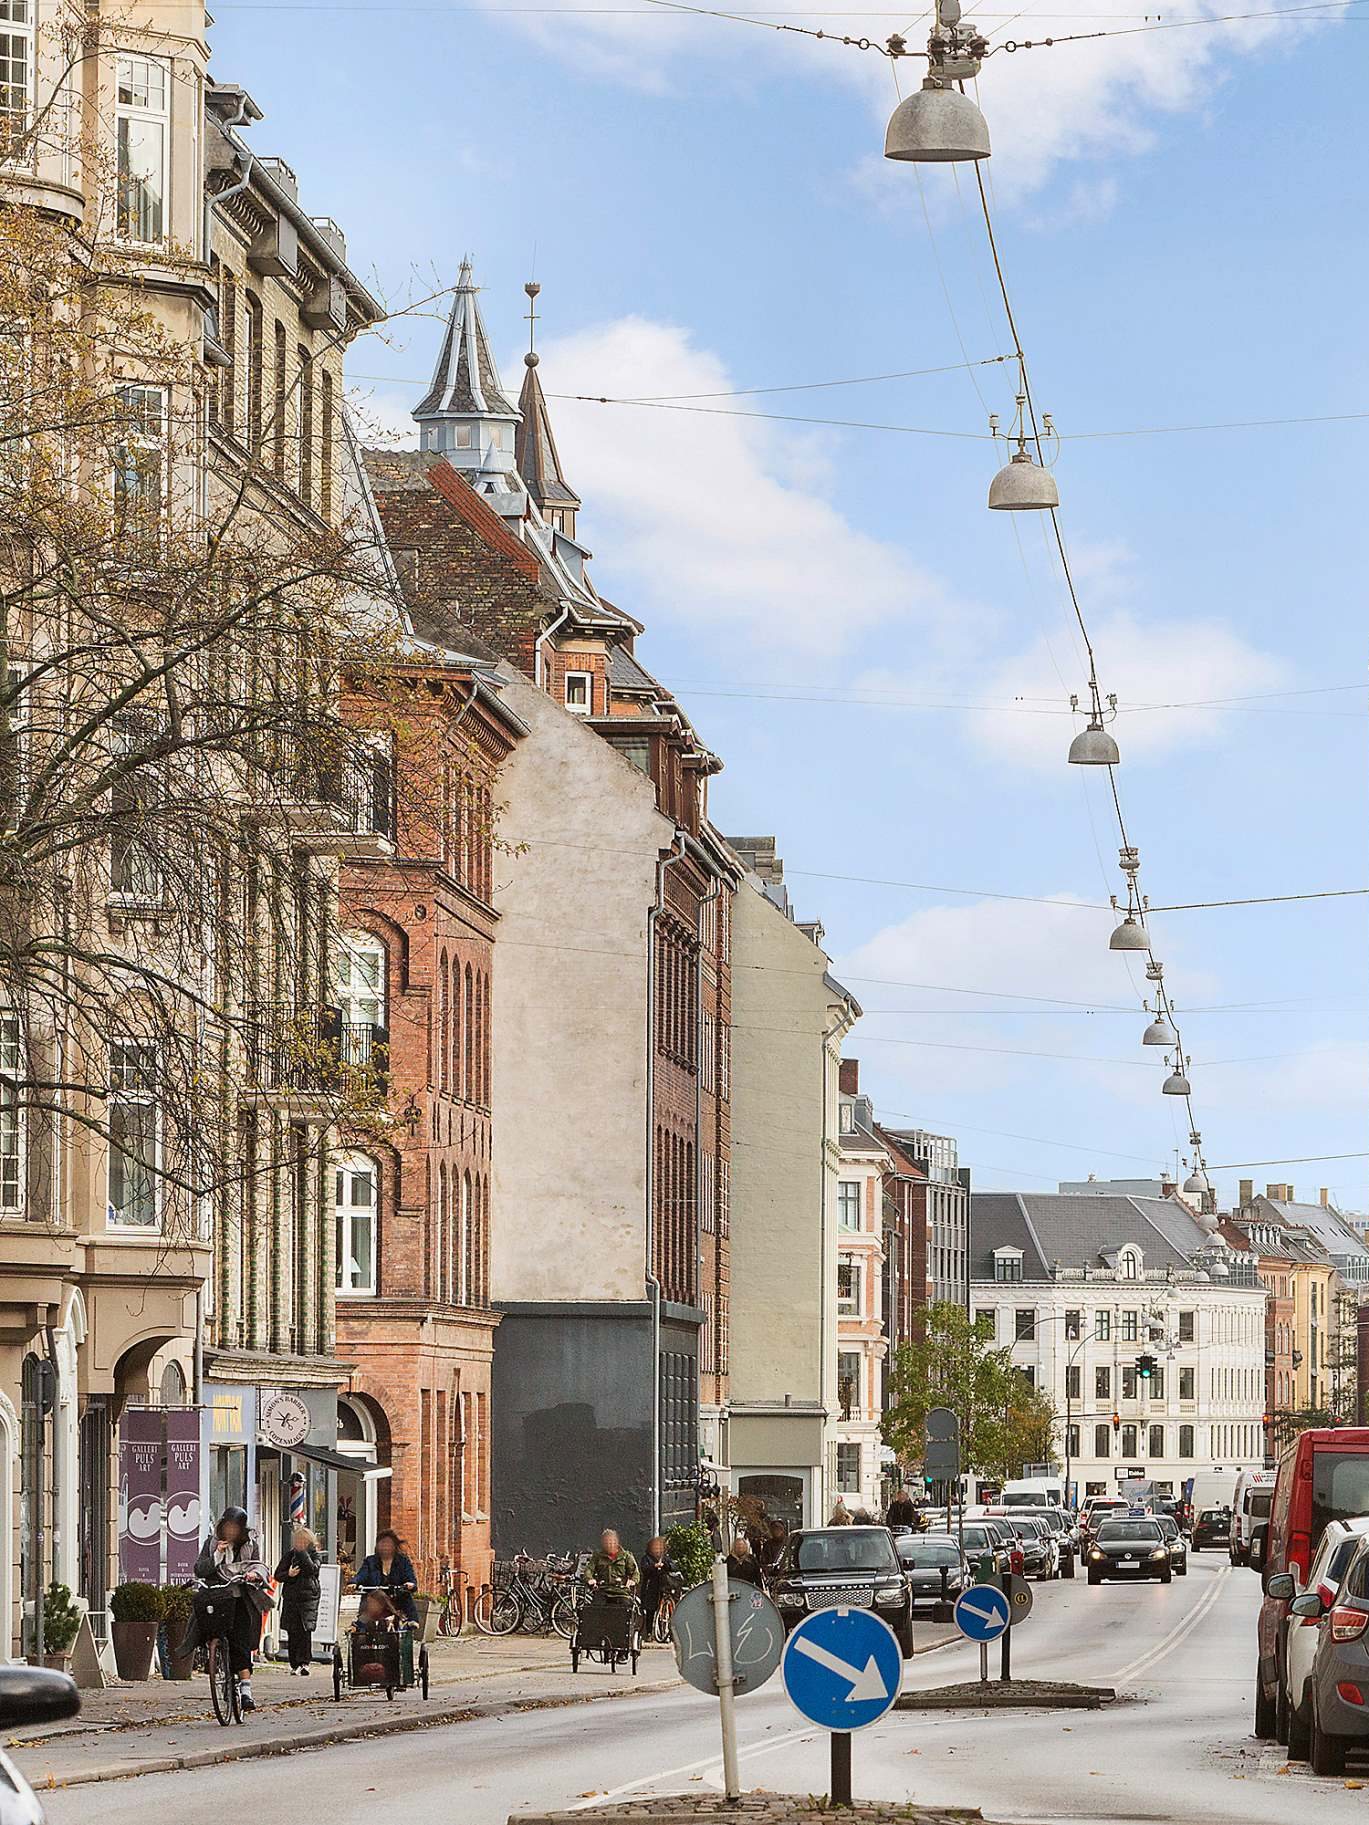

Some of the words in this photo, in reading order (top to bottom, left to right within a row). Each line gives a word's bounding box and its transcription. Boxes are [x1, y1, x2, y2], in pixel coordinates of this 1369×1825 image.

[284, 1395, 306, 1415] BARBER
[268, 1428, 306, 1445] COPENHAGEN
[131, 1445, 158, 1453] GALLERI
[171, 1444, 196, 1452] GALLERI
[135, 1453, 154, 1464] PULS
[174, 1452, 193, 1462] PULS
[139, 1464, 151, 1472] ART
[177, 1462, 189, 1470] ART
